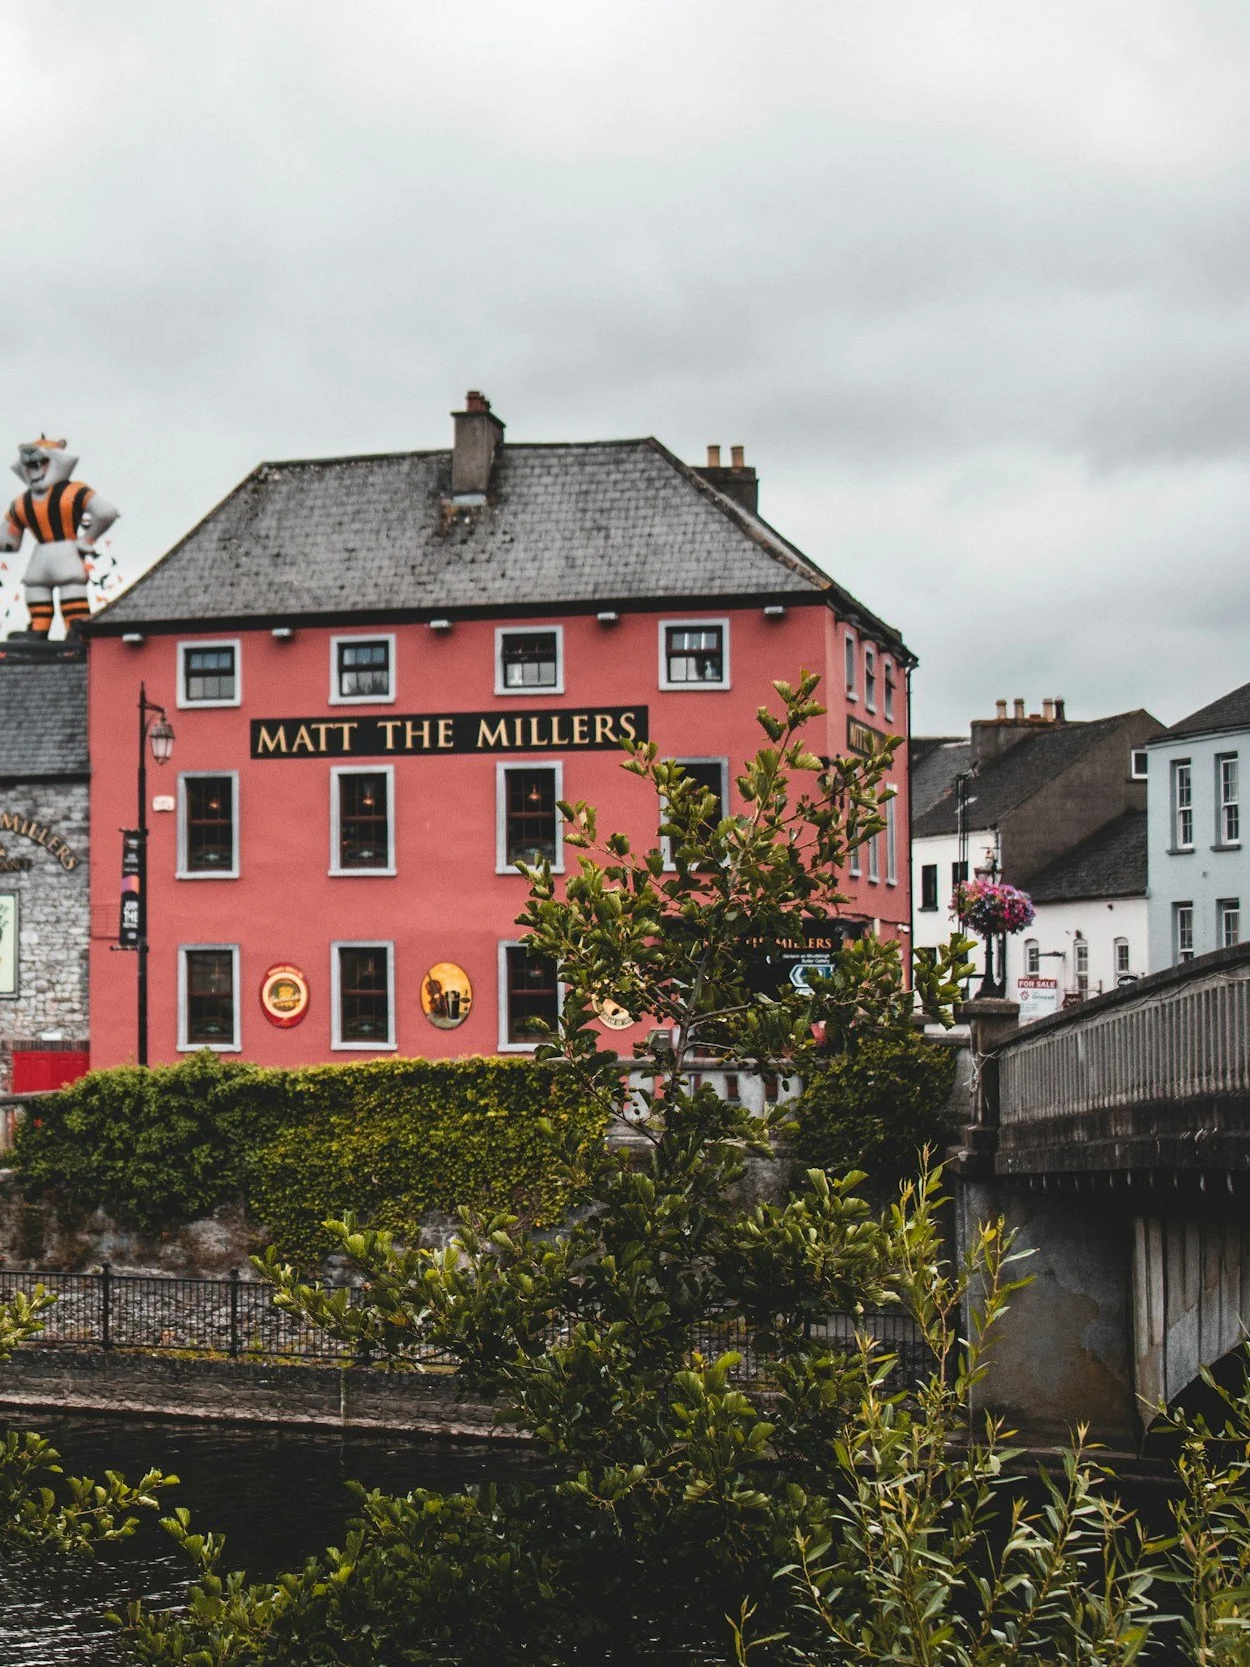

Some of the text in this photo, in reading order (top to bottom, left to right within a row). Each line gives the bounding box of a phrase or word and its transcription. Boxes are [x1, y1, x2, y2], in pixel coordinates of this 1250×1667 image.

[256, 711, 637, 754] MATT THE MILLERS
[0, 811, 78, 871] MILLERS
[1018, 980, 1056, 988] FOR SALE
